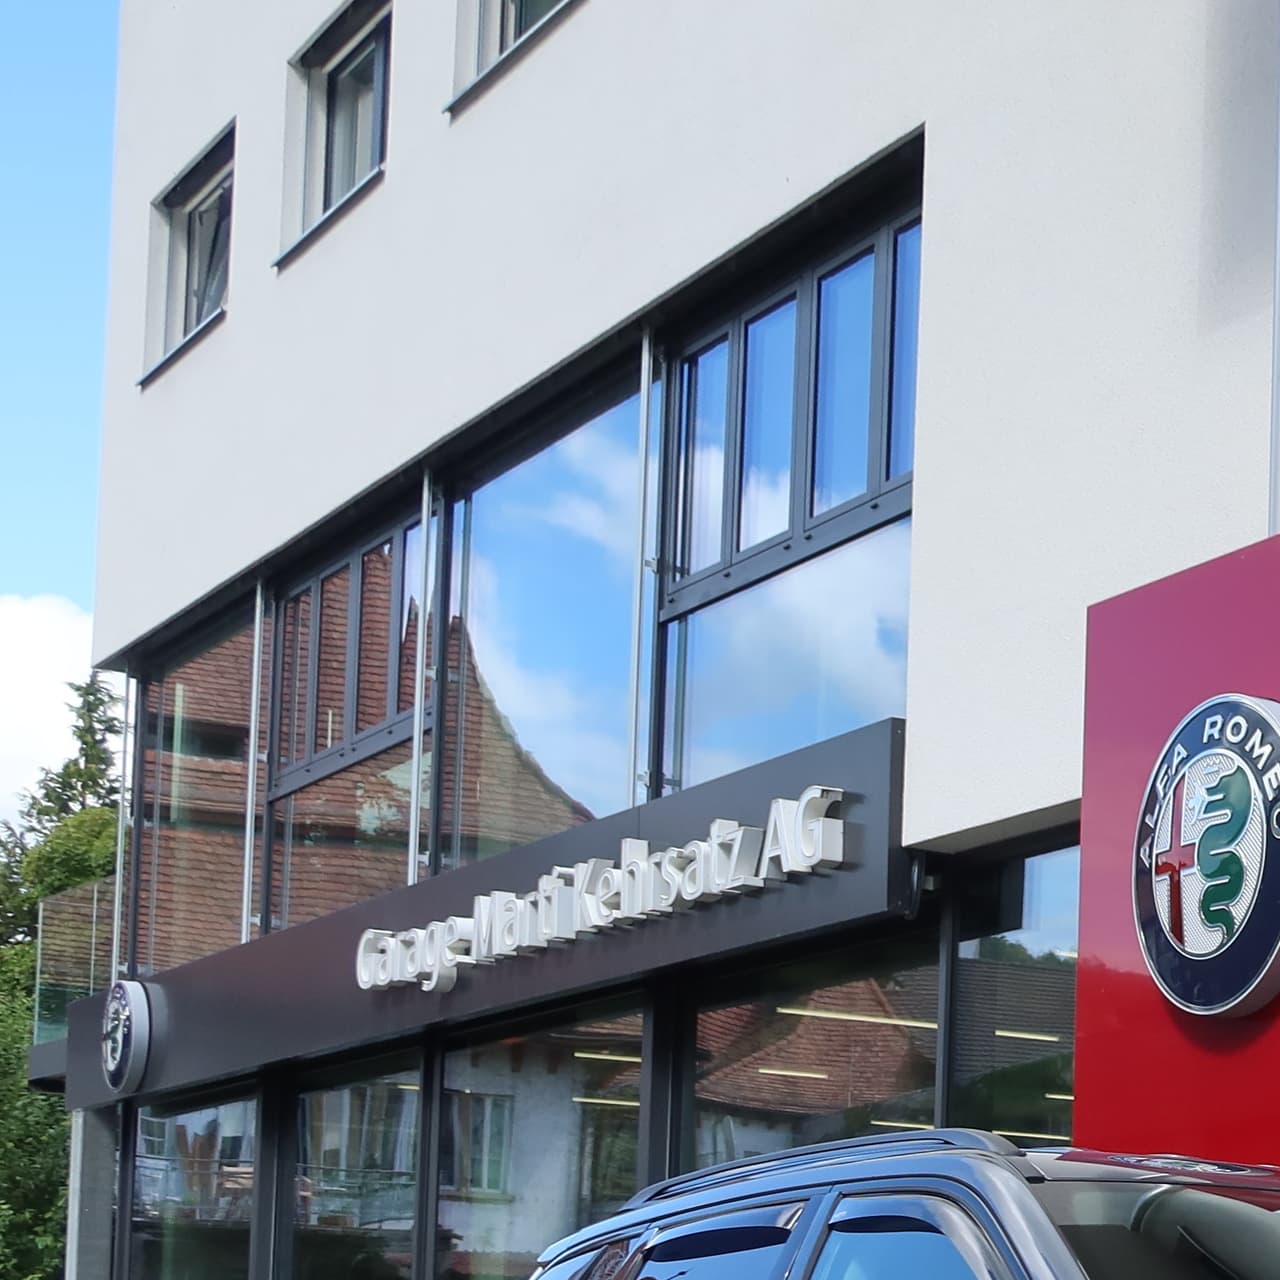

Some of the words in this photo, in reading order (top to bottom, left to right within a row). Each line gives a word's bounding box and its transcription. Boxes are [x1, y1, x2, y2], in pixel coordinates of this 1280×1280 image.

[356, 916, 474, 992] Garage
[475, 865, 576, 963] Marti
[573, 819, 763, 929] Kehrsatz
[758, 785, 844, 879] AG
[1140, 743, 1188, 868] ALFA
